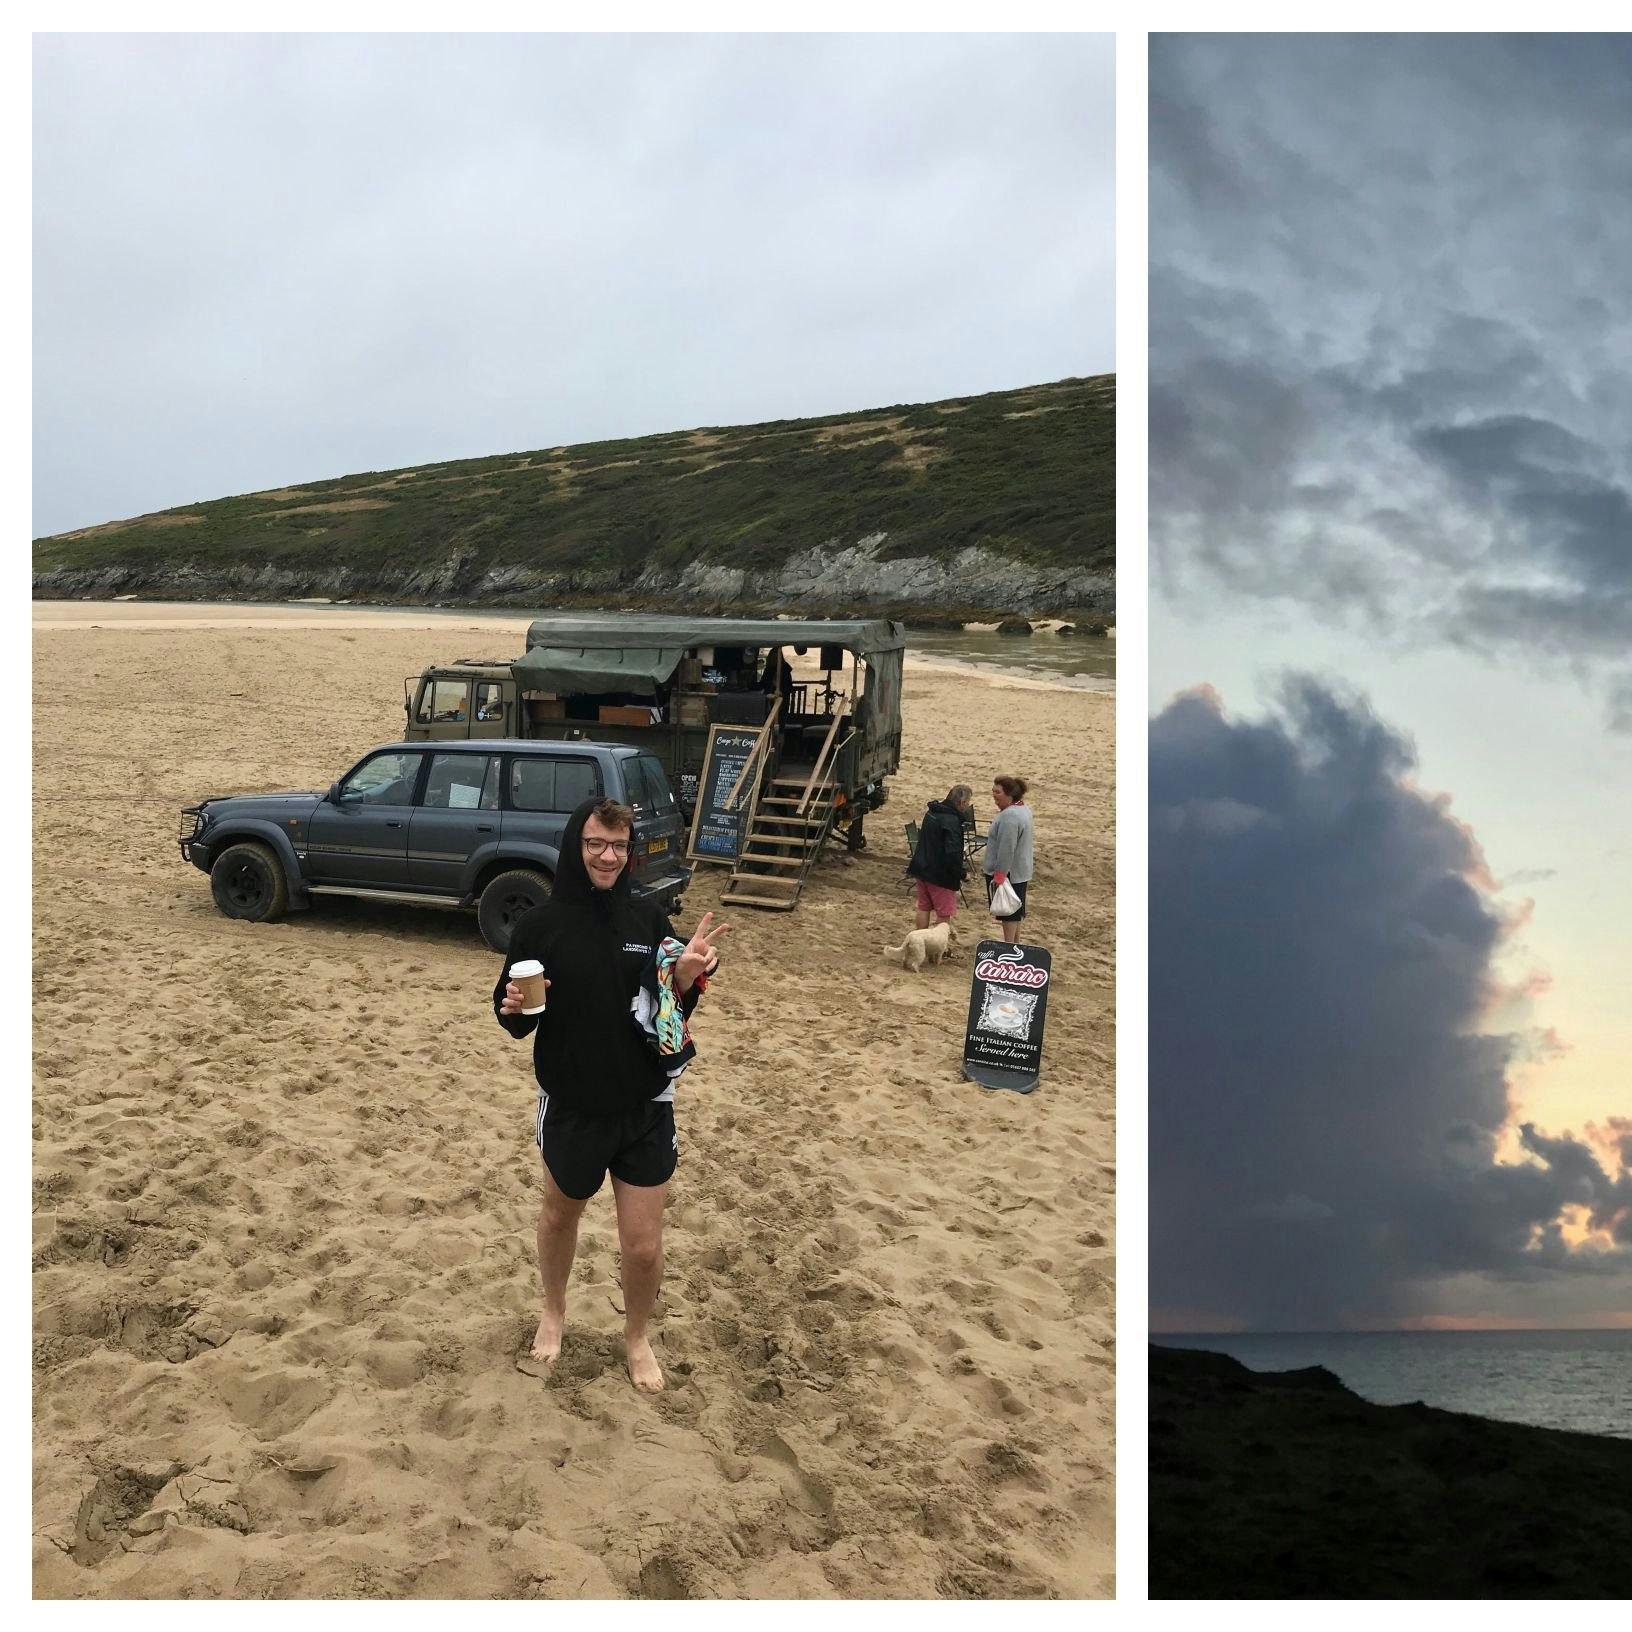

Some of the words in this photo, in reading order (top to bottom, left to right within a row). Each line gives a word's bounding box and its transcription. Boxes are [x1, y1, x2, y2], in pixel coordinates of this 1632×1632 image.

[969, 1034, 985, 1043] FINE
[986, 1037, 1013, 1047] ITALIAN
[1013, 1042, 1038, 1052] COFFEE
[975, 1043, 1010, 1056] Served
[1007, 1048, 1029, 1060] here
